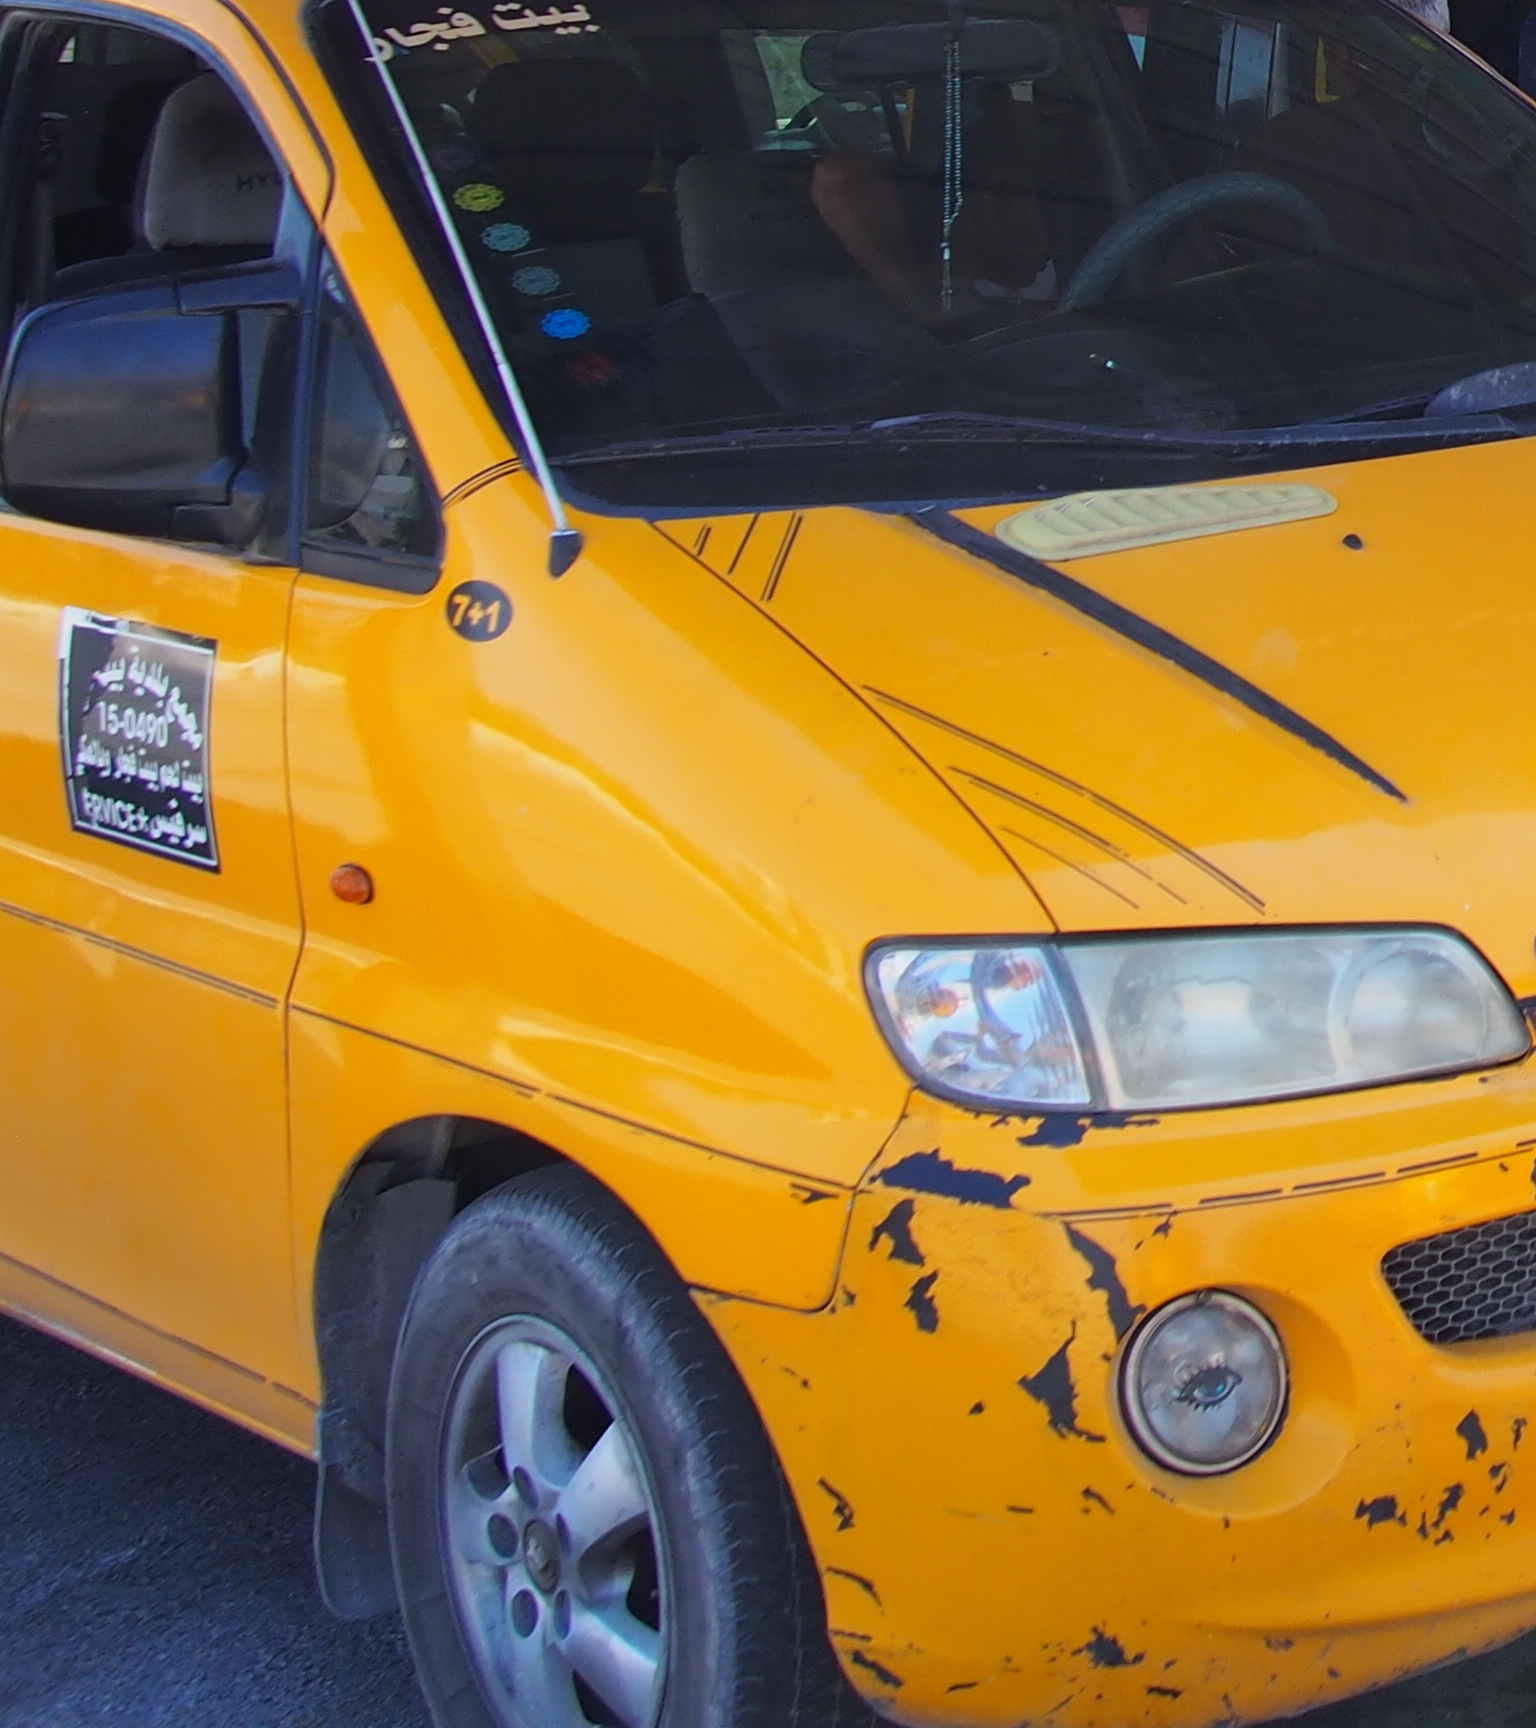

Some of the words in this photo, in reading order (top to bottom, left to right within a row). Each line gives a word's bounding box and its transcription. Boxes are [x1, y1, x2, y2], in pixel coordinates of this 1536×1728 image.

[491, 1, 601, 36] بيت
[452, 594, 501, 633] 7+1
[97, 701, 169, 748] 15-0490
